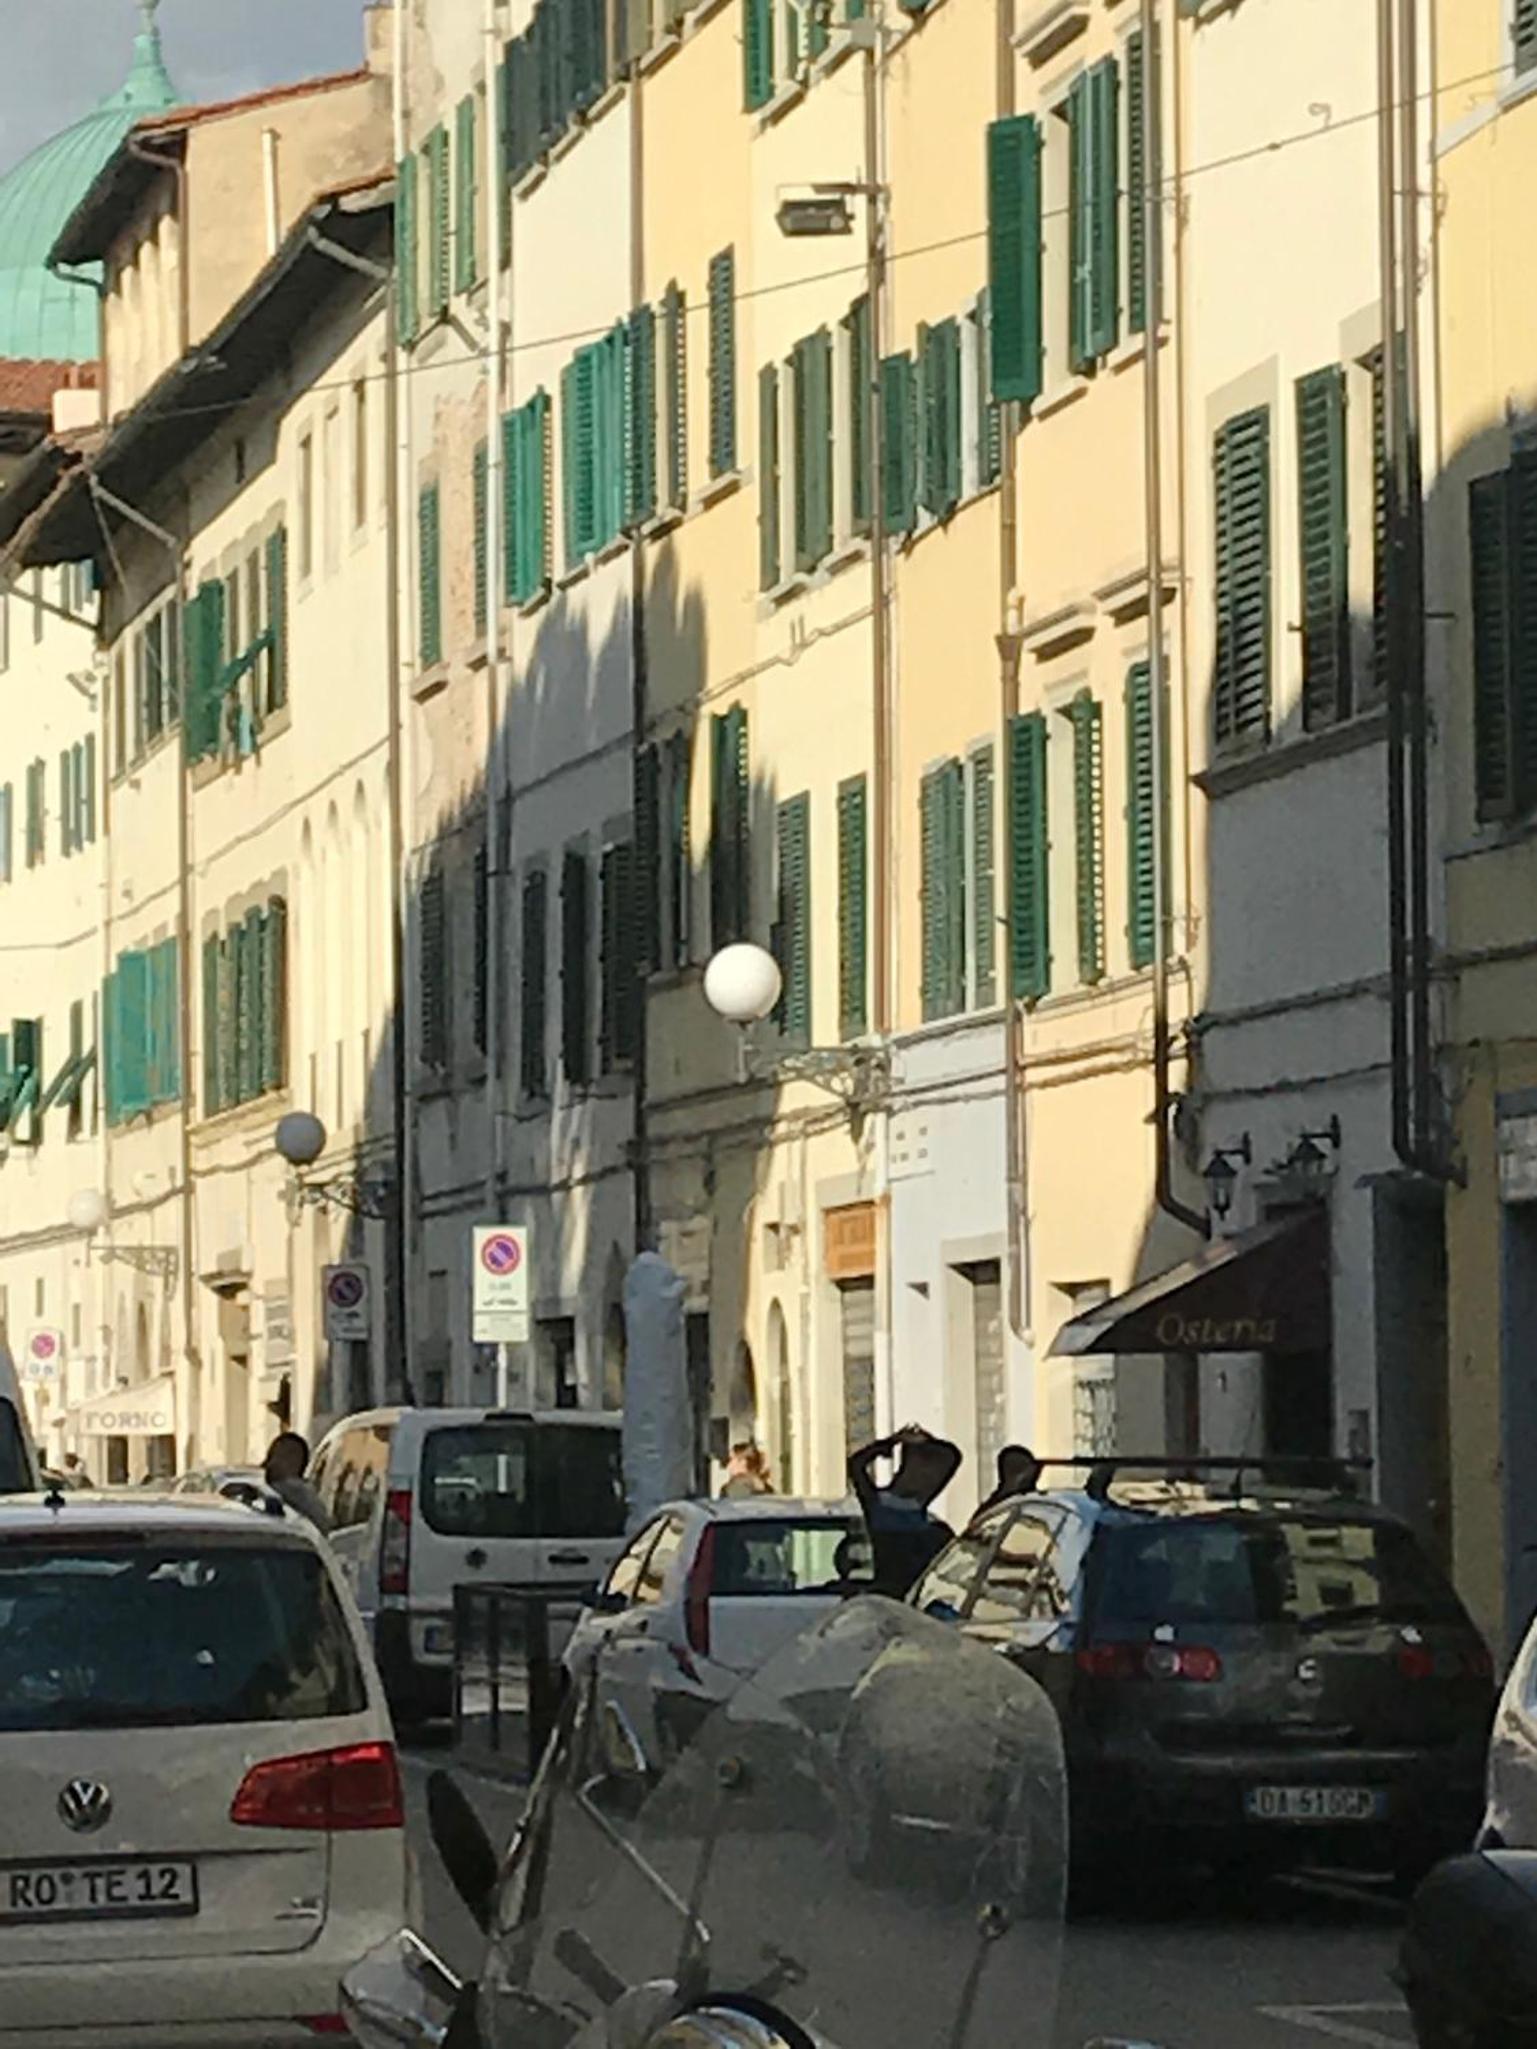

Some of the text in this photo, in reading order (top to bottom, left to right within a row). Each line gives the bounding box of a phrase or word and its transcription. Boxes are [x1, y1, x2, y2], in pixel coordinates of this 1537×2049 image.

[1157, 1314, 1276, 1345] Osteria
[10, 1866, 180, 1908] RO TE 12
